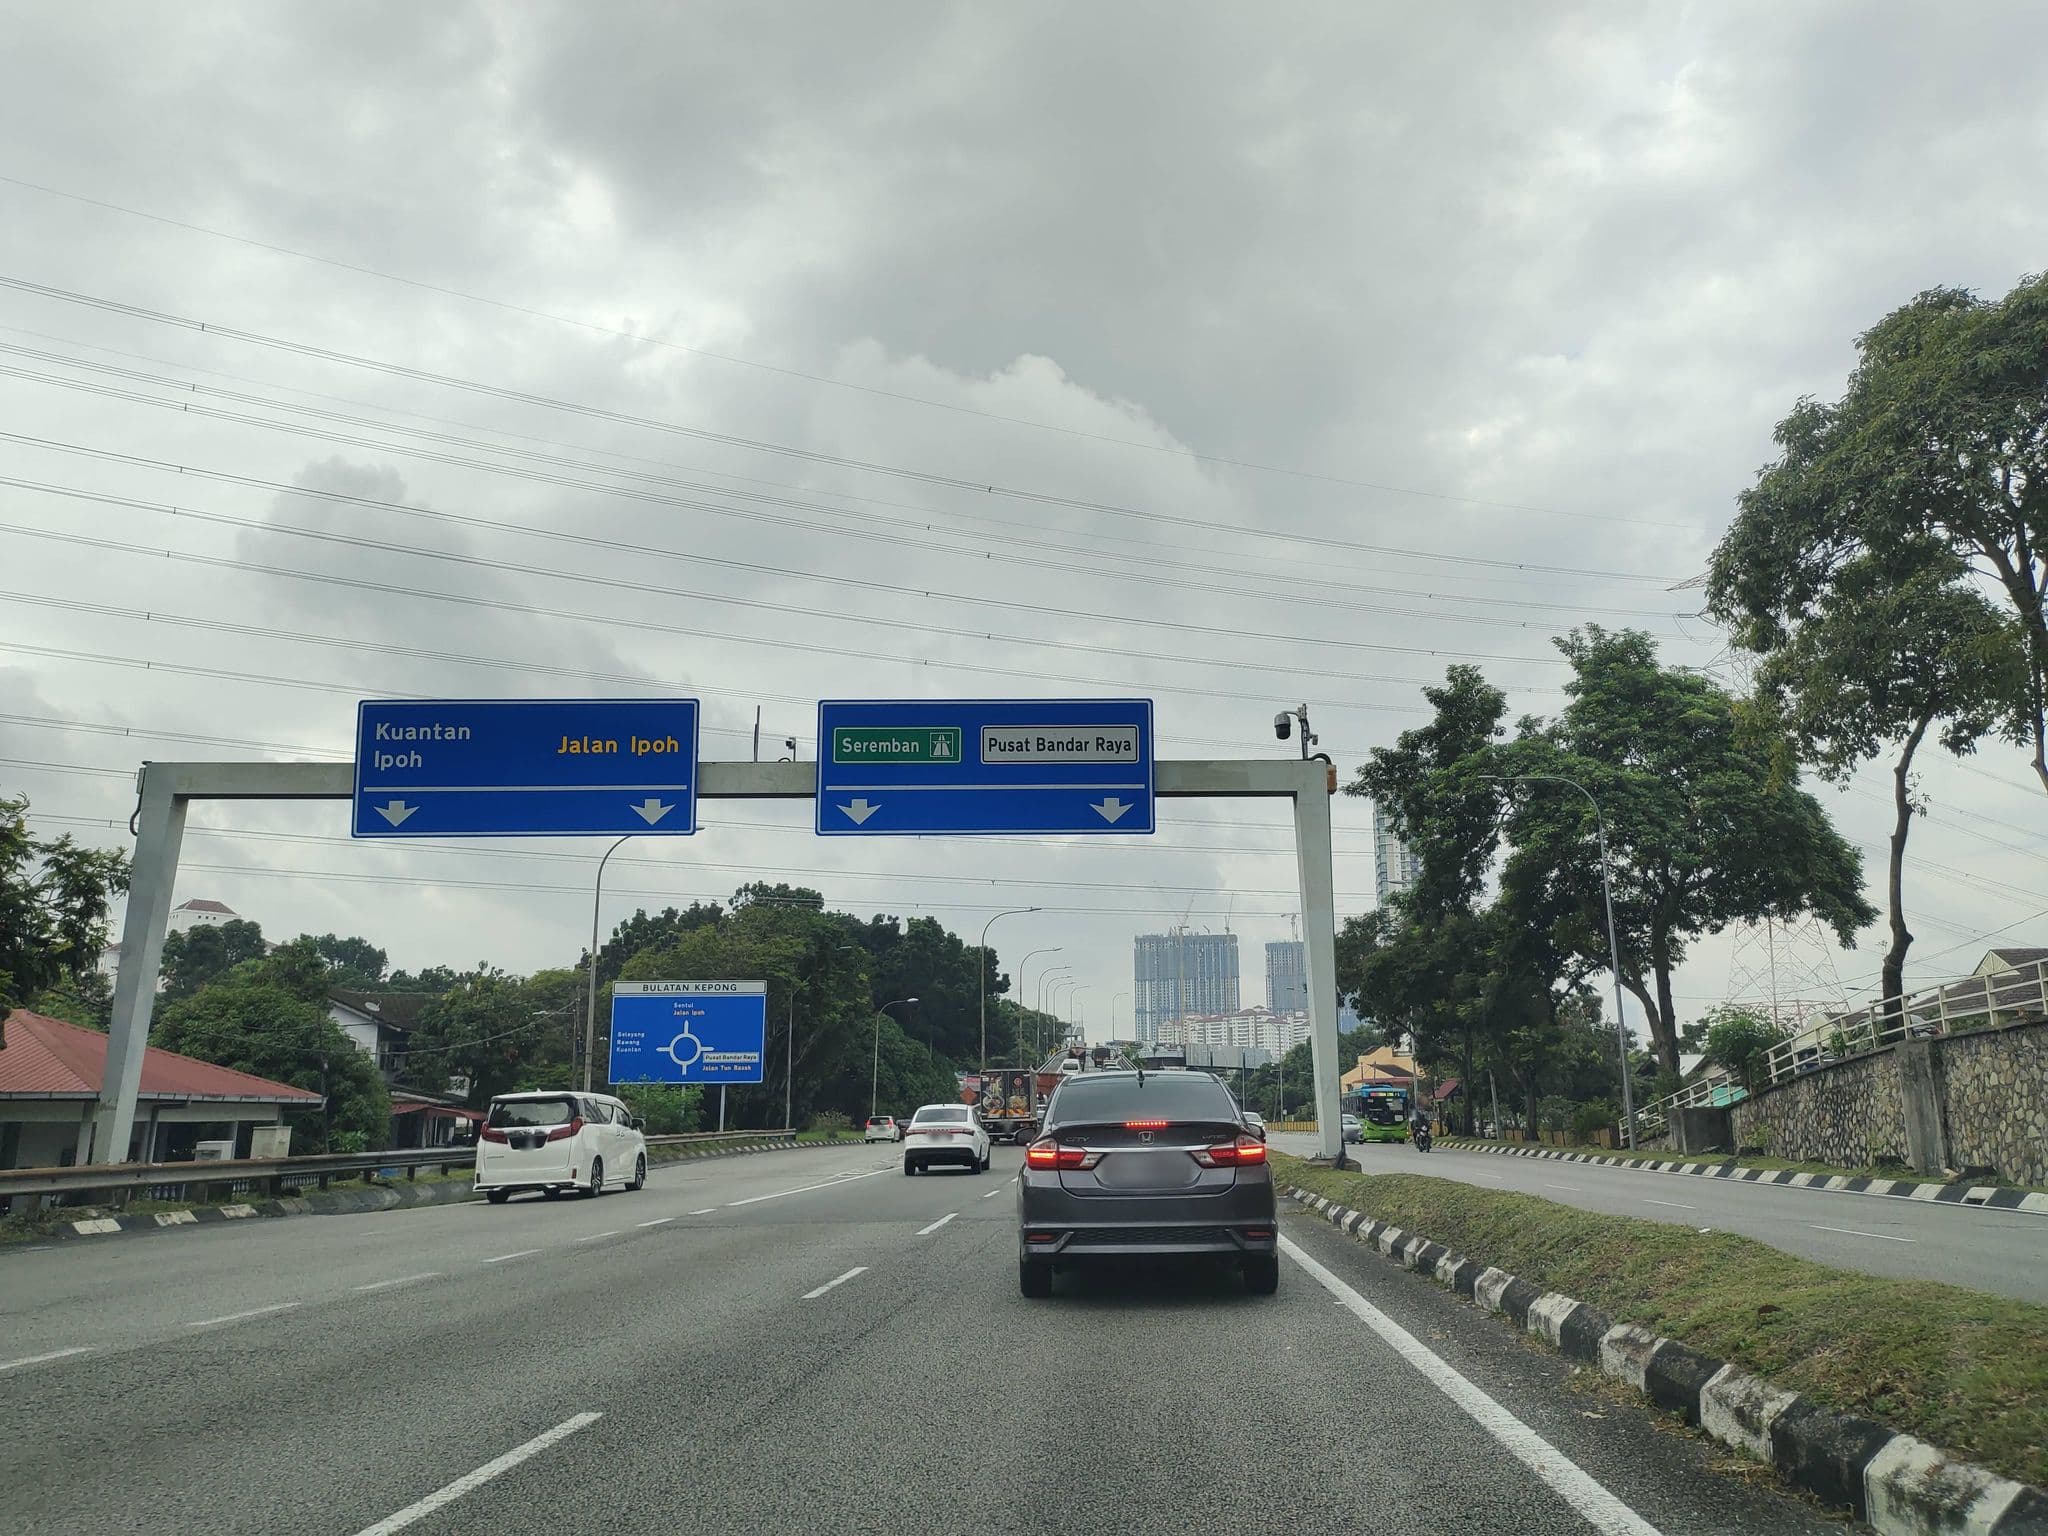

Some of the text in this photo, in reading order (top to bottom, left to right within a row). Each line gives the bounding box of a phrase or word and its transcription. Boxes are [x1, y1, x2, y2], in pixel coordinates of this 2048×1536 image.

[376, 722, 471, 741] Kuantan
[557, 735, 679, 756] Jalan Ipoh
[842, 737, 919, 753] Seremban
[988, 737, 1132, 755] Pusat Bandar Raya
[374, 750, 422, 771] Ipoh
[642, 983, 737, 992] BULATAN KEPONG
